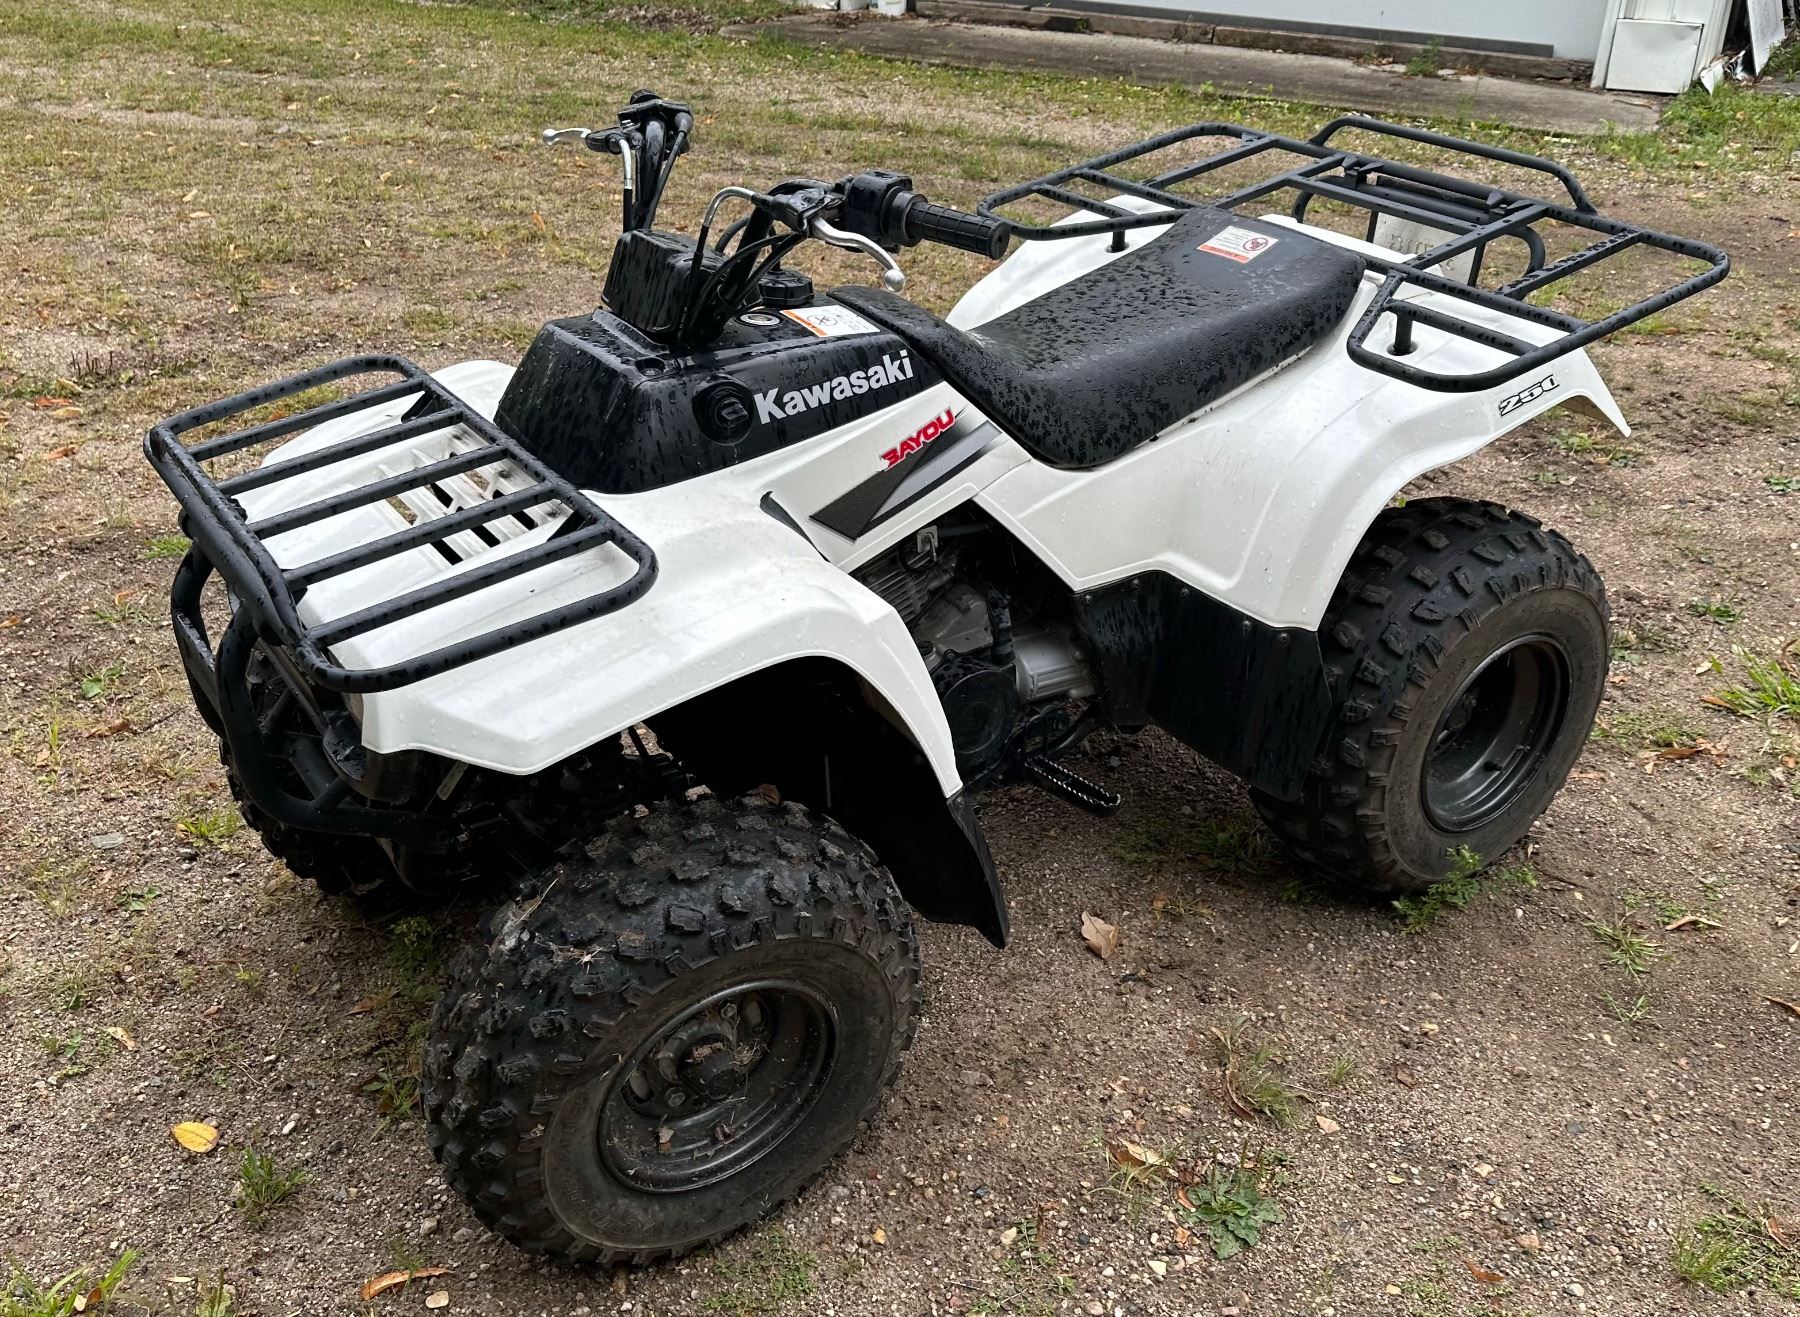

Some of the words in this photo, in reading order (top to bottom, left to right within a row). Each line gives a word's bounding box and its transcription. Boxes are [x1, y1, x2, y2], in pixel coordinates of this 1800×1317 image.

[754, 349, 914, 424] Kawasaki
[1498, 374, 1560, 416] 250
[880, 408, 956, 470] BAYOU
